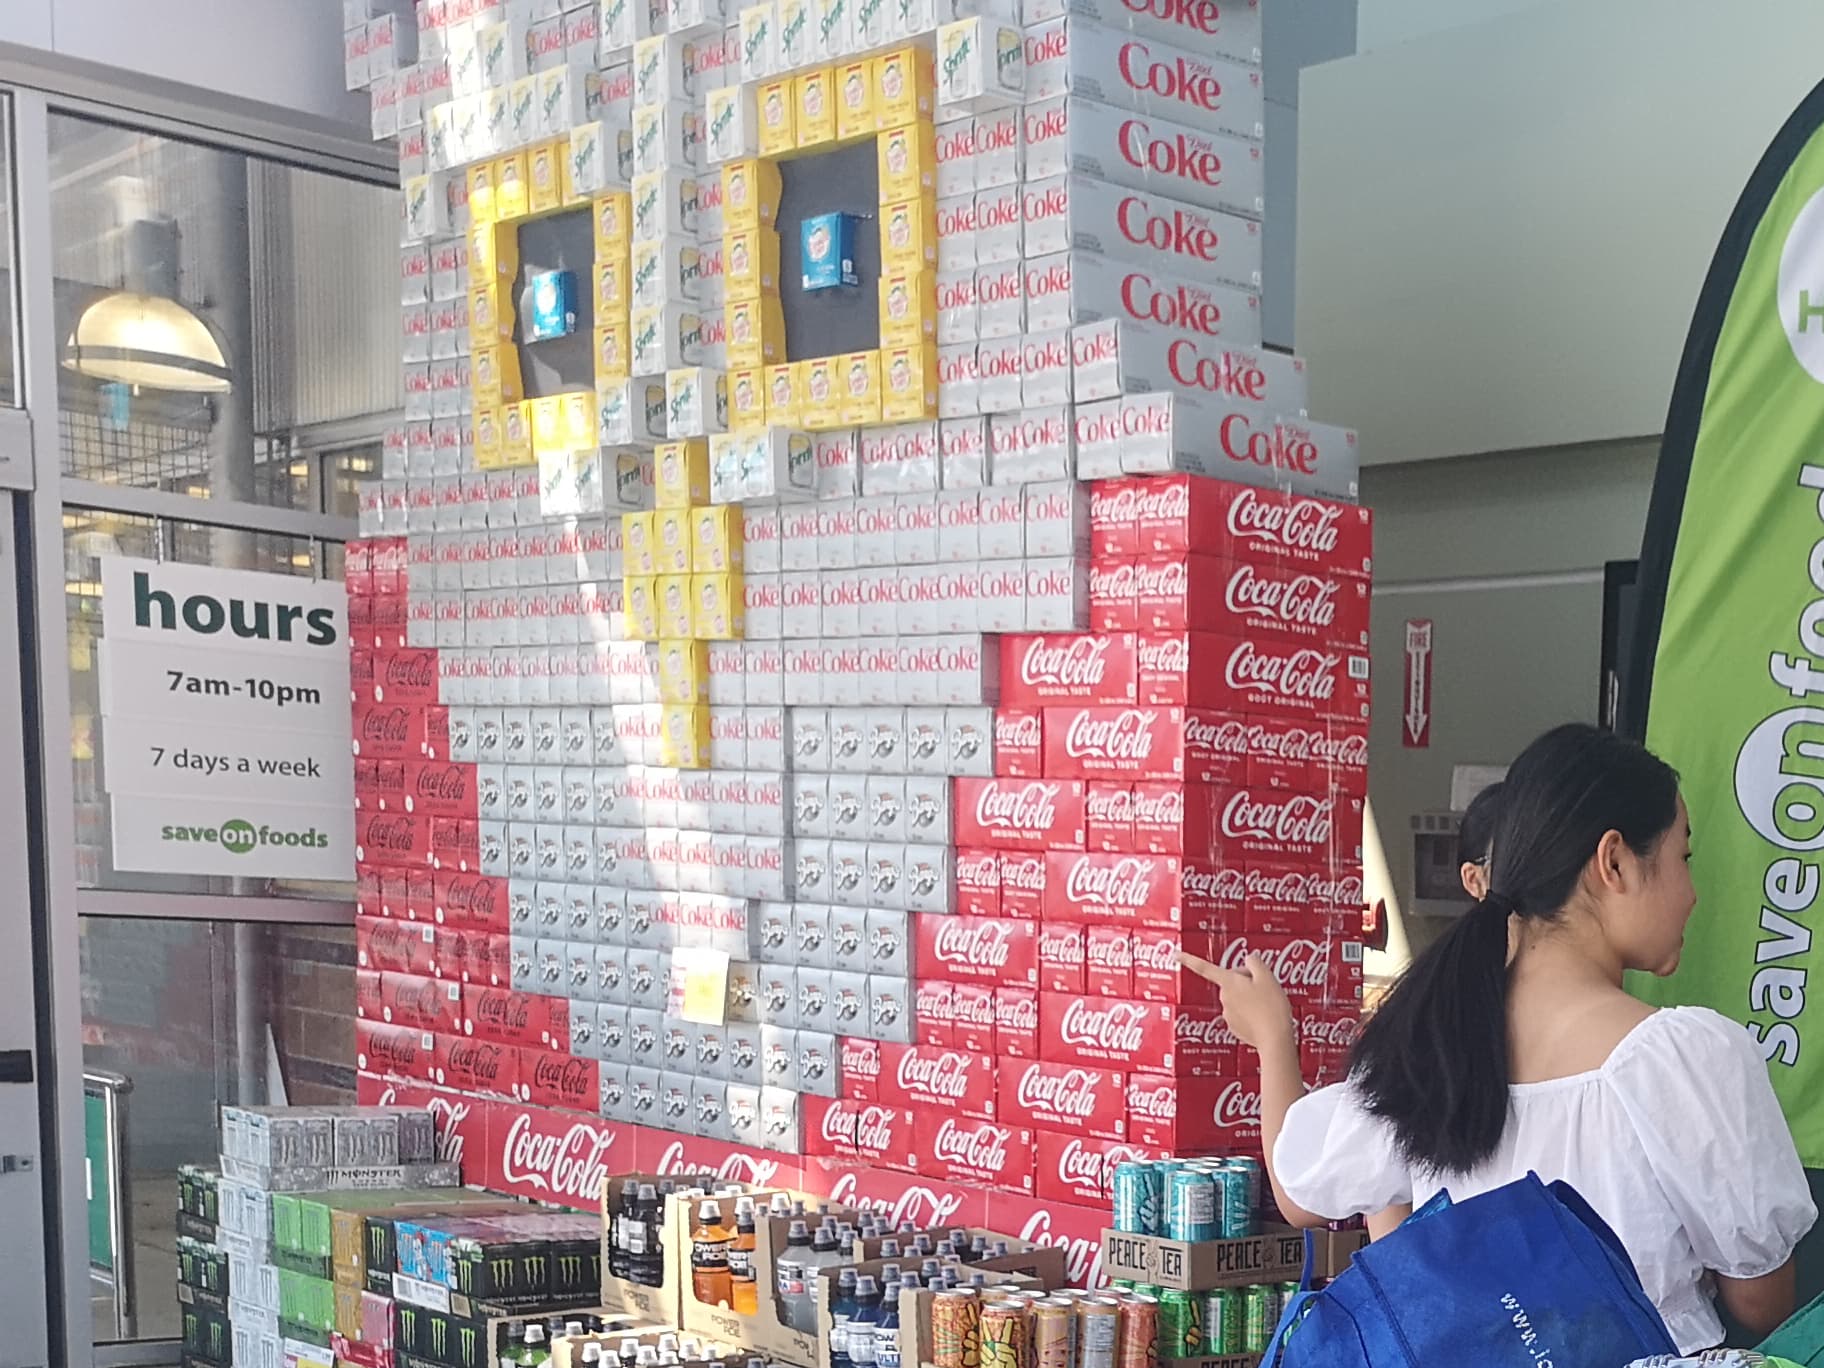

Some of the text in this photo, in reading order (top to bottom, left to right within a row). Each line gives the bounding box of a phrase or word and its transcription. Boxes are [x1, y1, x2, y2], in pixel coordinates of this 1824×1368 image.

[1025, 32, 1066, 66] Coke
[1118, 42, 1222, 111] Coke
[975, 122, 1016, 154] Coke
[1118, 119, 1222, 187] Coke
[978, 199, 1018, 229] Coke
[1023, 190, 1066, 222] Coke
[1117, 197, 1218, 262] Coke
[1026, 268, 1070, 298] Coke
[1121, 273, 1220, 336] Coke
[979, 349, 1022, 378] Coke
[1024, 342, 1067, 372] Coke
[1167, 339, 1265, 401] Coke
[1074, 415, 1120, 443] Coke
[1123, 407, 1169, 435] Coke
[1220, 413, 1317, 475] Coke
[898, 504, 935, 530] Coke
[1027, 493, 1069, 521] Coke
[1227, 488, 1344, 552] Coca-Cola
[1249, 542, 1320, 562] ORIGINAL TASTE
[1026, 570, 1069, 596] Coke
[1225, 565, 1340, 626] Coca-Cola
[133, 571, 337, 646] hours
[1247, 618, 1317, 636] ORIGINAL TASTE
[938, 646, 977, 672] Coke
[1021, 636, 1110, 685] Coca-Cola
[1225, 641, 1340, 699] Coca-Cola
[167, 670, 321, 706] 7am-10pm
[1066, 709, 1158, 758] Coca-Cola
[151, 748, 321, 778] 7 days a week
[976, 781, 1060, 829] Coca-Cola
[1222, 790, 1333, 844] Coca-Cola
[1242, 841, 1312, 853] ORIGINAL TASTE
[1067, 856, 1156, 906] Coca-Cola
[934, 918, 1015, 966] Coca-Cola
[1061, 999, 1148, 1051] Coca-Cola
[535, 1047, 590, 1094] Coca-Cola
[897, 1046, 971, 1098] Coca-Cola
[1018, 1063, 1100, 1117] Coca-Cola
[822, 1101, 896, 1151] Coca-Cola
[935, 1118, 1012, 1172] Coca-Cola
[502, 1112, 616, 1213] Coca-Cola
[1108, 1237, 1147, 1271] PEACE
[1159, 1244, 1184, 1278] TEA
[1217, 1241, 1261, 1273] PEACE
